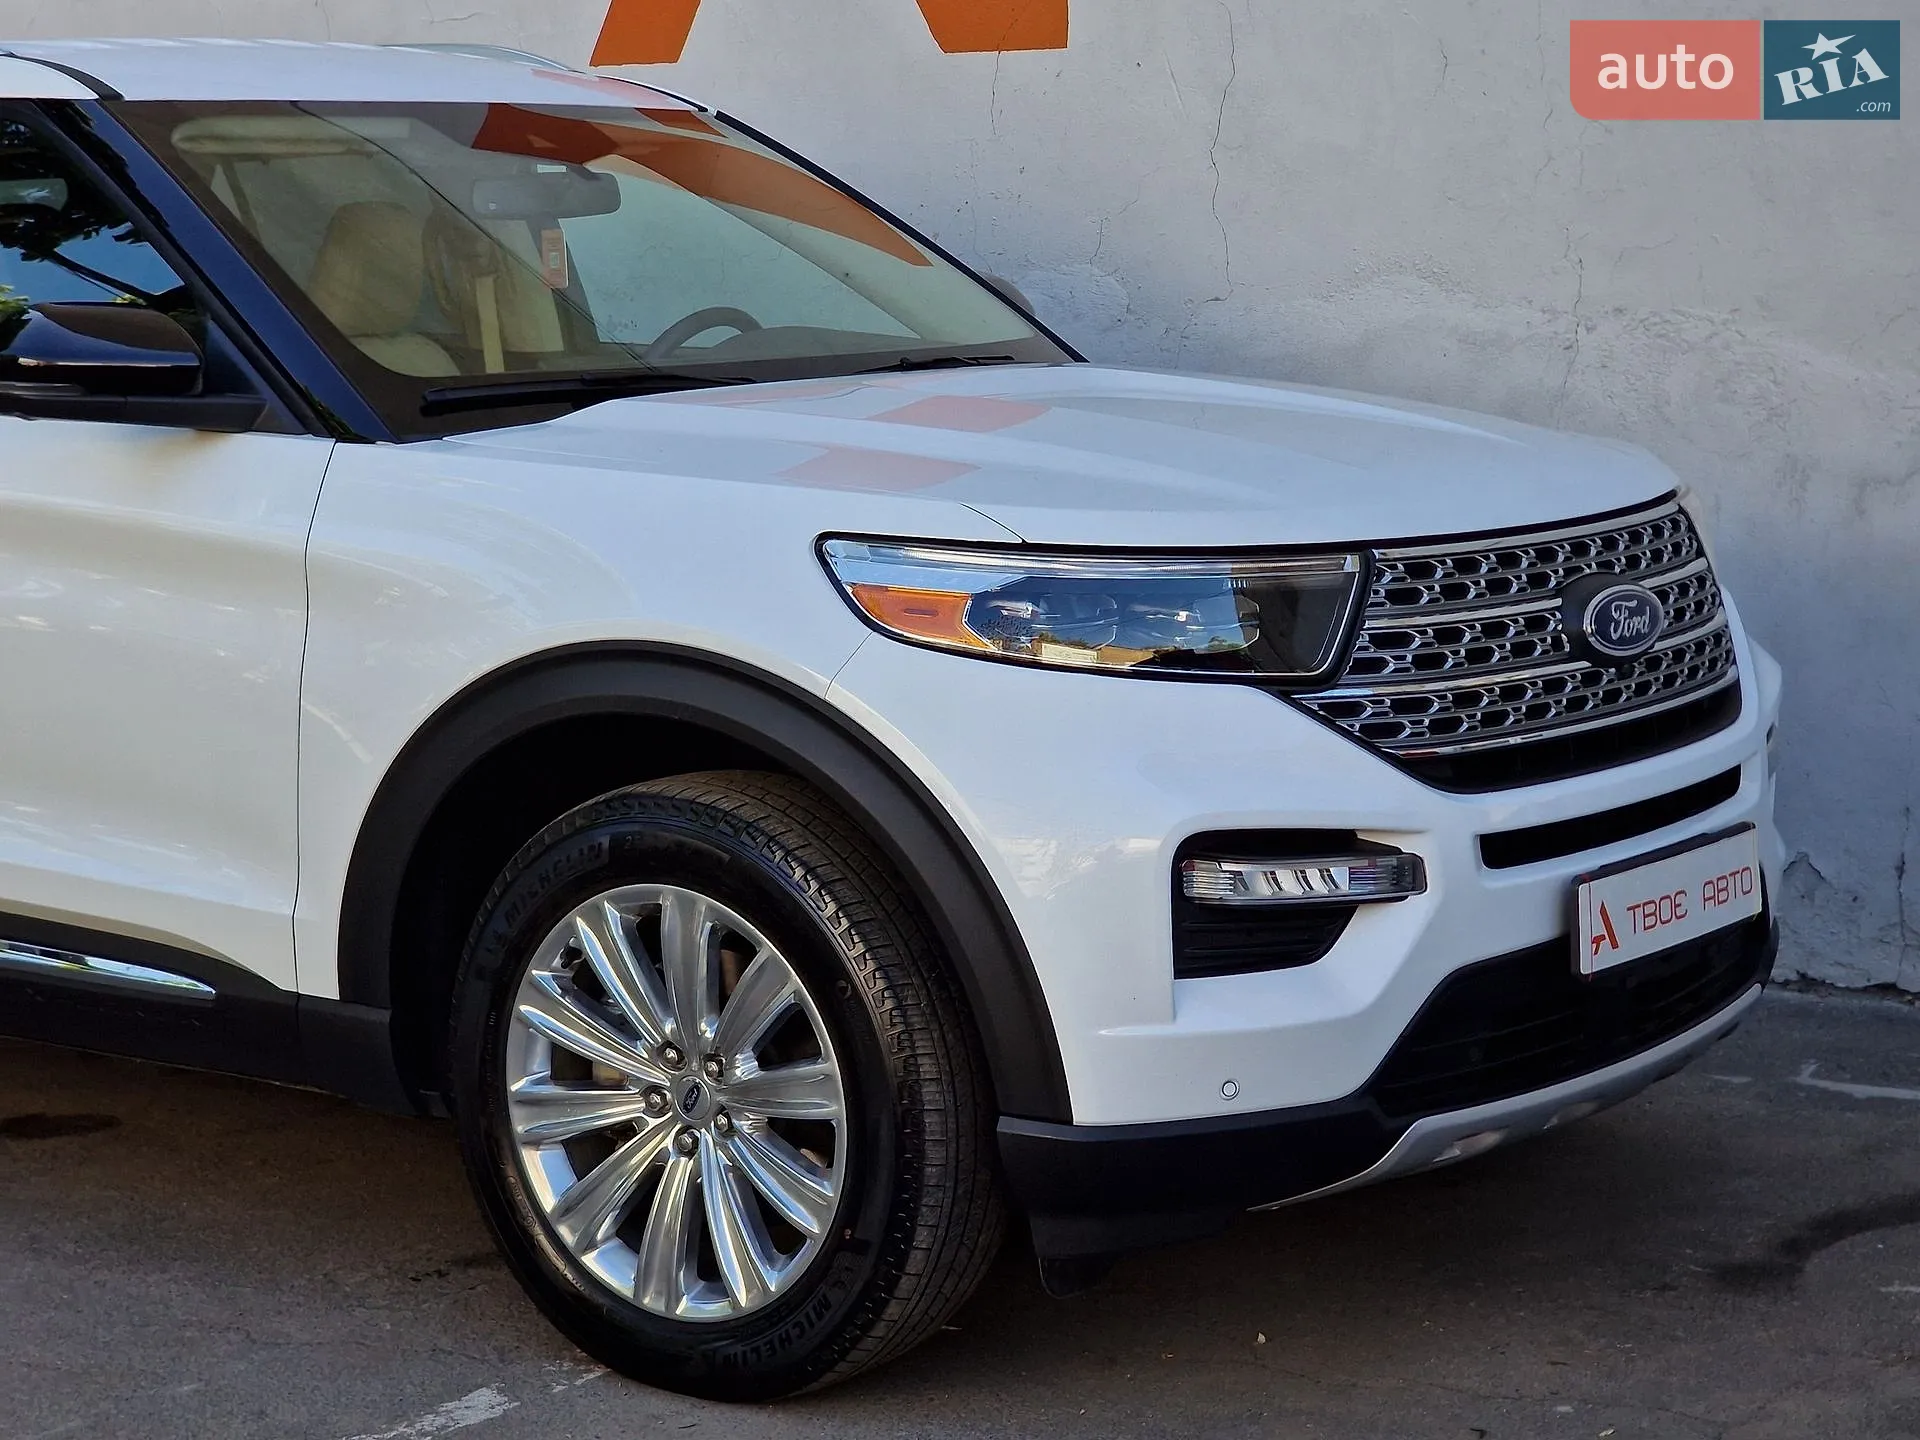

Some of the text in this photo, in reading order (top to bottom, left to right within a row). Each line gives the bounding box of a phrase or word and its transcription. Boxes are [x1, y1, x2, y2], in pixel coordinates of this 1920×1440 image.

[1610, 599, 1651, 640] Ford
[1702, 866, 1753, 911] АВТО
[722, 1293, 833, 1367] MICHELIN
